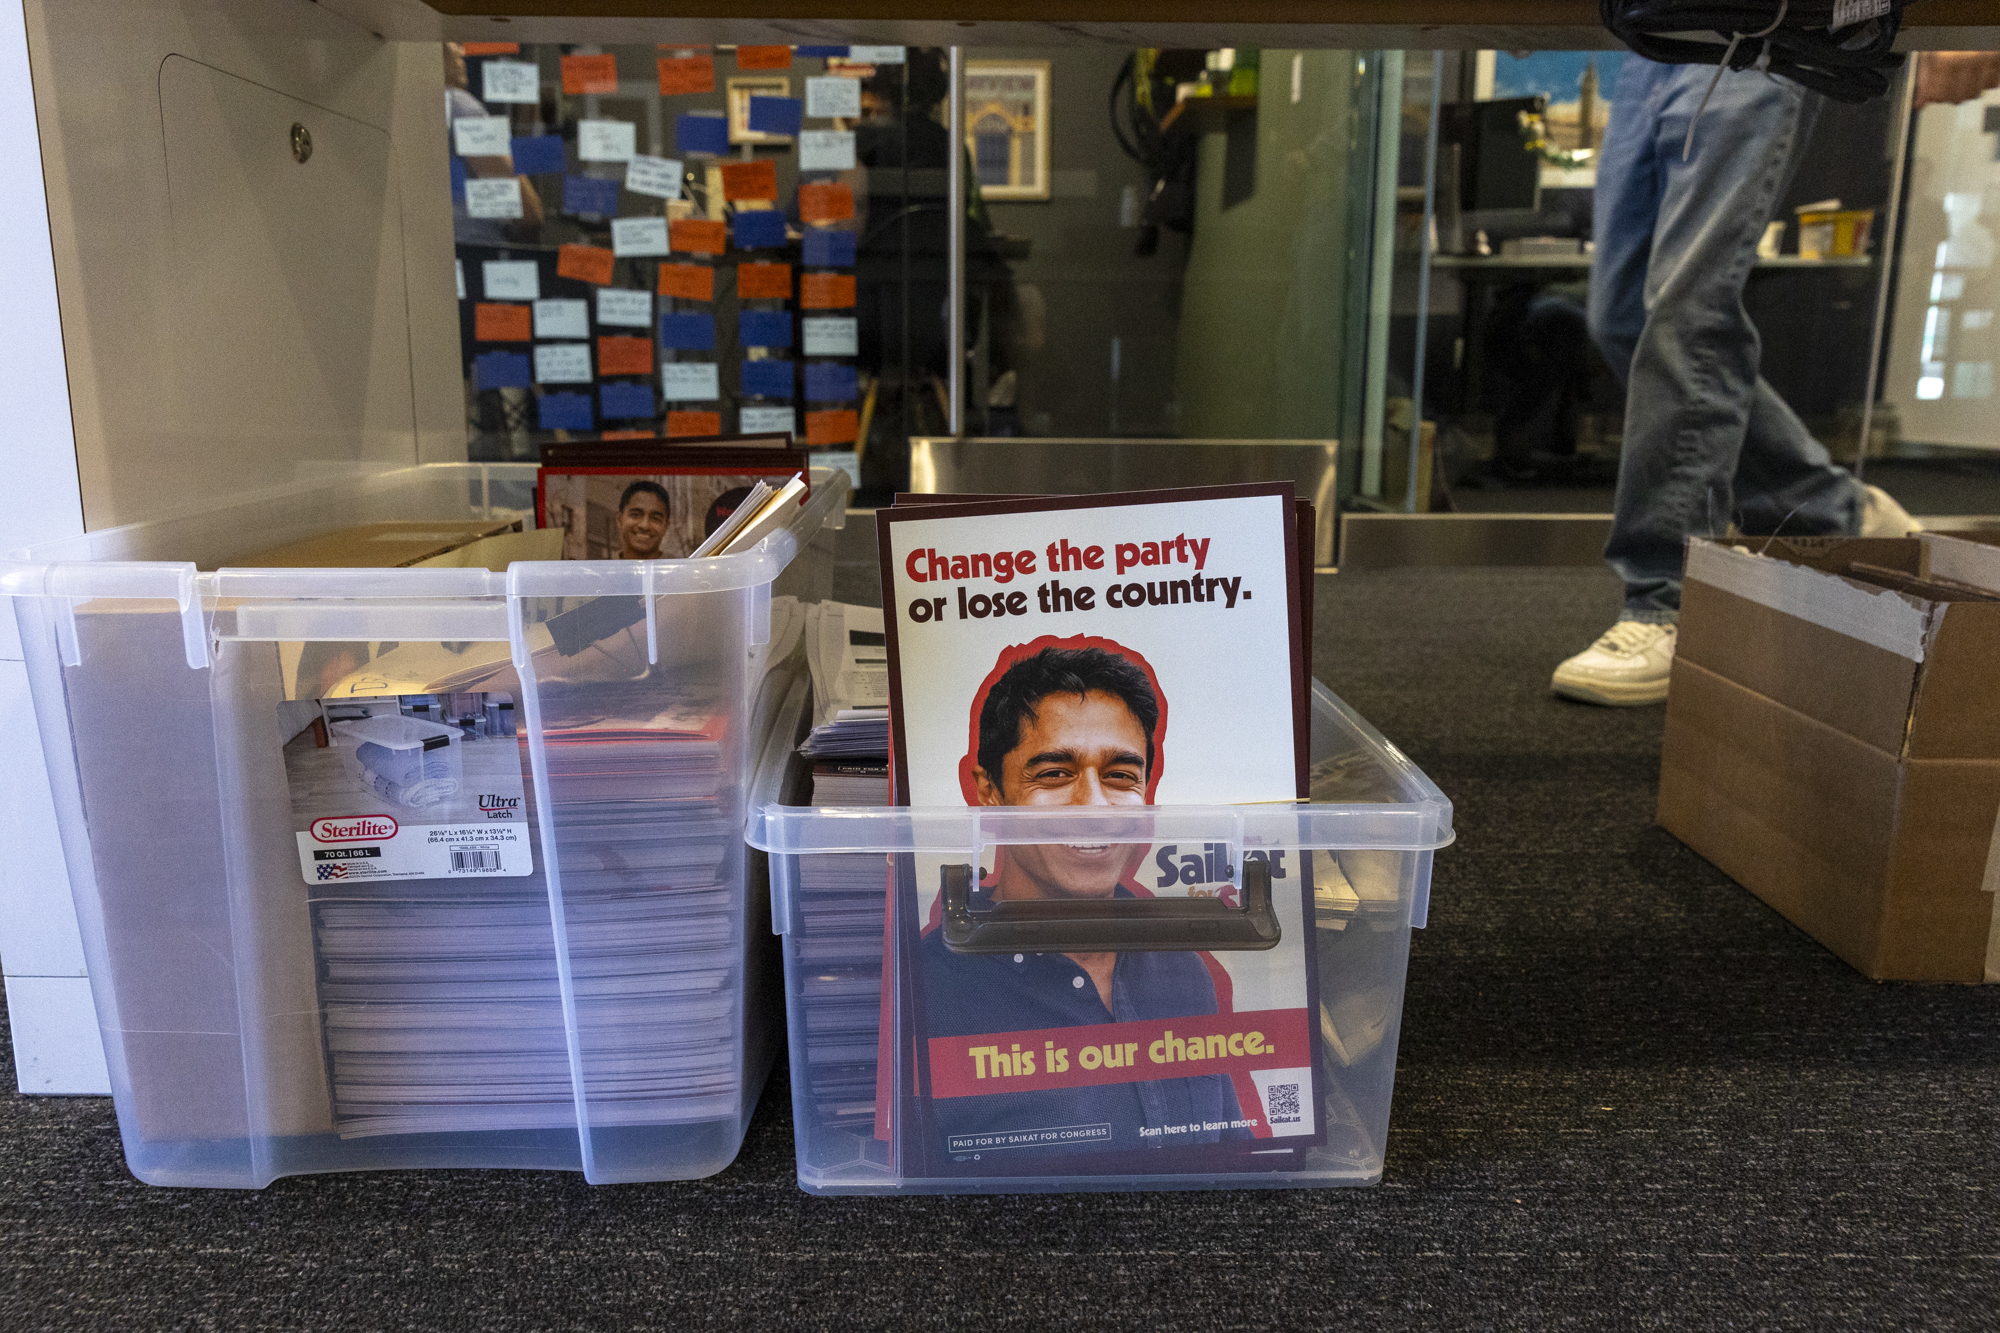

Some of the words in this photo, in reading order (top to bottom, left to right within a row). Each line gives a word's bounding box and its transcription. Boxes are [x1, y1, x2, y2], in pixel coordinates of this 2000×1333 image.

[906, 548, 1036, 583] Change
[1046, 539, 1104, 572] the
[1115, 533, 1210, 575] party
[909, 597, 947, 623] or
[958, 587, 1027, 619] lose
[1037, 580, 1095, 613] the
[1106, 572, 1251, 608] country.
[487, 809, 512, 818] Latch
[969, 1044, 1035, 1078] This
[1046, 1041, 1069, 1072] is
[1079, 1043, 1138, 1069] our
[1149, 1031, 1274, 1063] chance.
[1139, 1127, 1162, 1136] Scan
[1164, 1125, 1187, 1134] here
[1190, 1123, 1200, 1132] to
[1203, 1121, 1228, 1130] learn
[1231, 1119, 1257, 1128] more
[1270, 1116, 1300, 1124] Saikat.us
[976, 1138, 992, 1146] FOR
[1008, 1134, 1038, 1142] SAIKAT
[1060, 1128, 1107, 1139] CONGRESS
